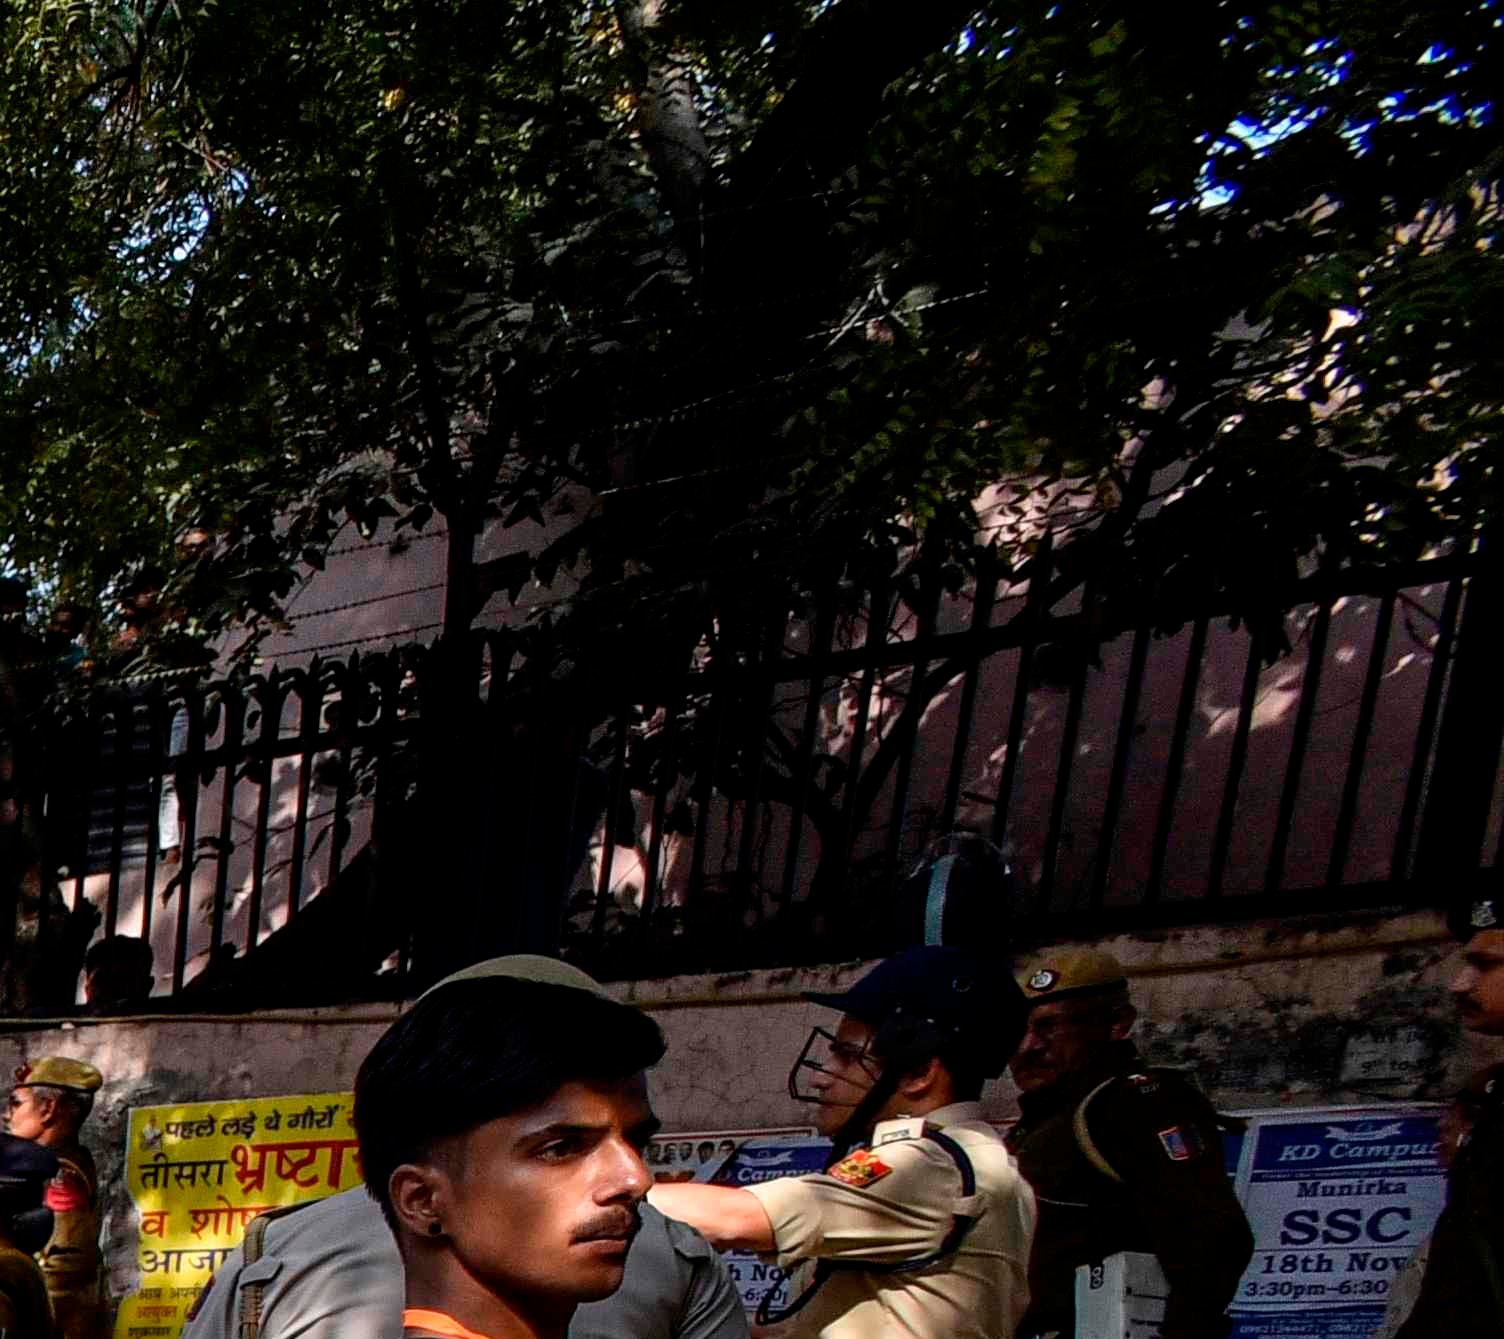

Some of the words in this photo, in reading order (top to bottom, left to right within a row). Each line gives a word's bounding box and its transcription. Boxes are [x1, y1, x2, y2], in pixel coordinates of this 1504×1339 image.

[165, 1113, 217, 1140] पहले
[221, 1111, 258, 1140] लड़े
[264, 1109, 282, 1131] थे
[1277, 1144, 1322, 1162] KD
[139, 1153, 228, 1189] तीसरा
[231, 1139, 362, 1196] भ्रष्टा
[1297, 1179, 1408, 1198] Munirka
[142, 1210, 169, 1239] व
[1280, 1207, 1412, 1246] SSC
[142, 1248, 234, 1273] आजा
[1262, 1254, 1333, 1274] 18th
